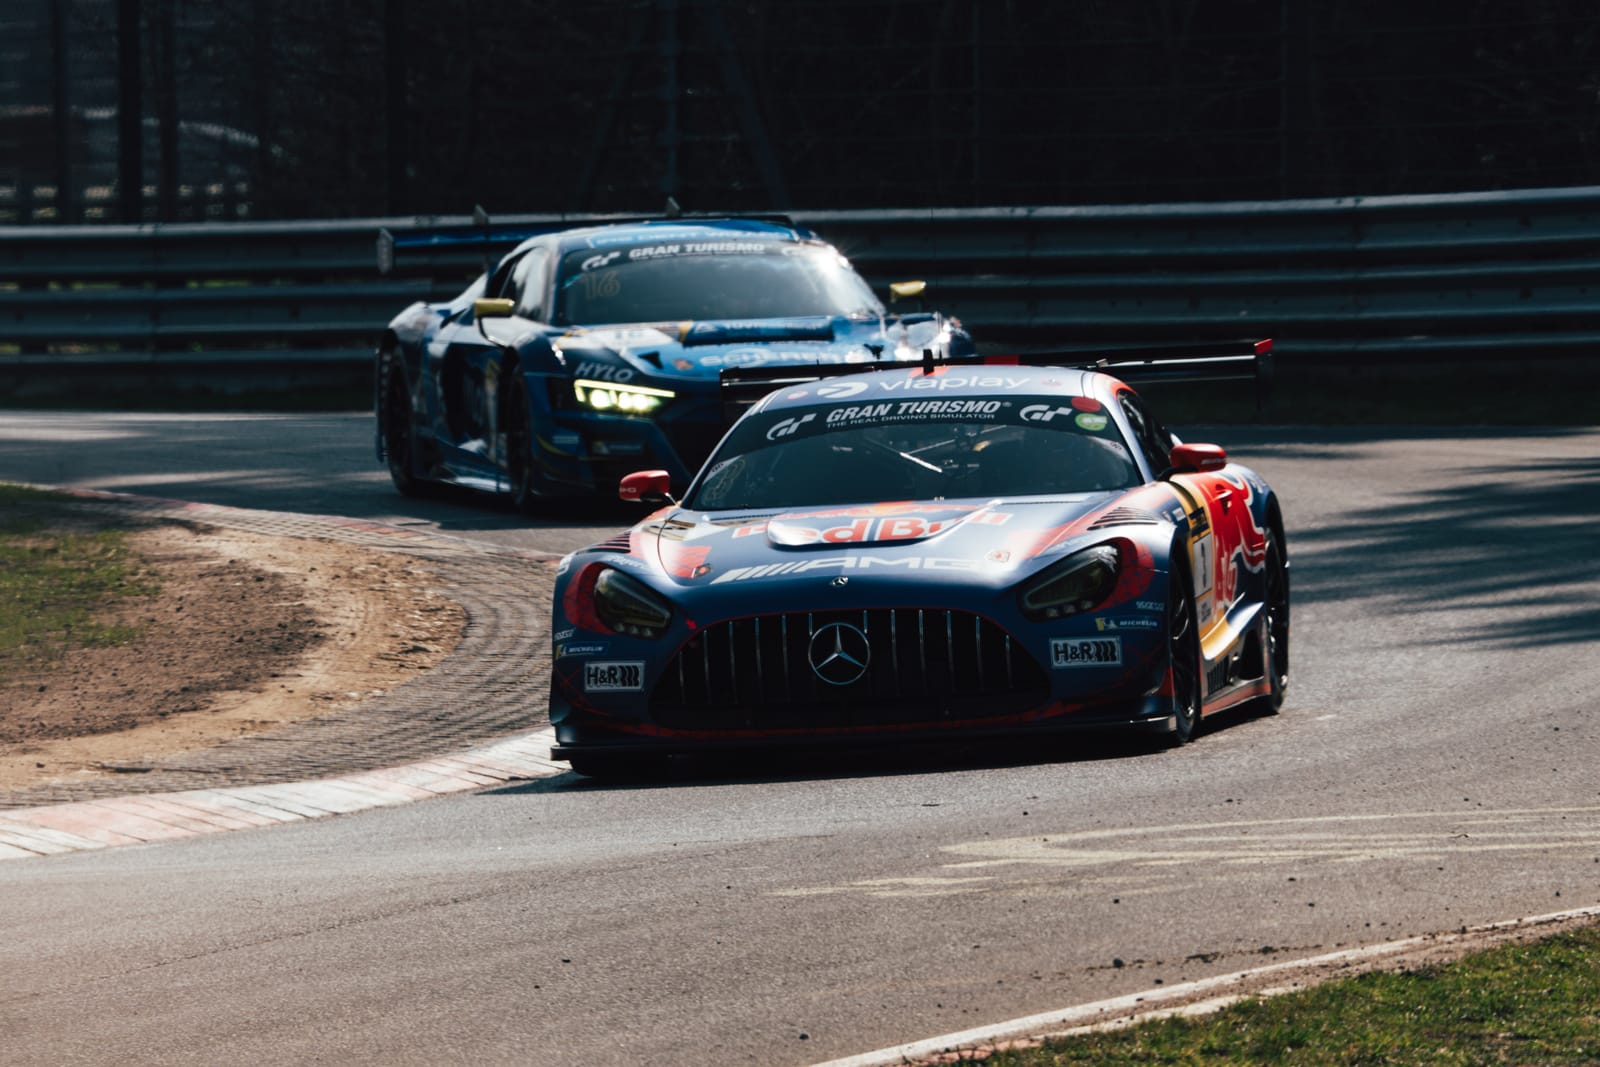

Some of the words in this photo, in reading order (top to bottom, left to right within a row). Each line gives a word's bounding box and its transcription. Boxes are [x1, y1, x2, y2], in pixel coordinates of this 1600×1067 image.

[628, 244, 680, 259] GRAN
[685, 241, 766, 253] TURISMO
[574, 361, 634, 383] HYLO
[879, 373, 1031, 391] viaplay
[826, 403, 893, 423] GRAN
[827, 420, 847, 429] THE
[850, 416, 878, 425] REAL
[881, 413, 927, 422] DRIVING
[930, 412, 996, 420] SIMULATOR
[795, 556, 972, 574] AMG
[1053, 642, 1093, 663] H&R
[587, 665, 618, 684] H&R
